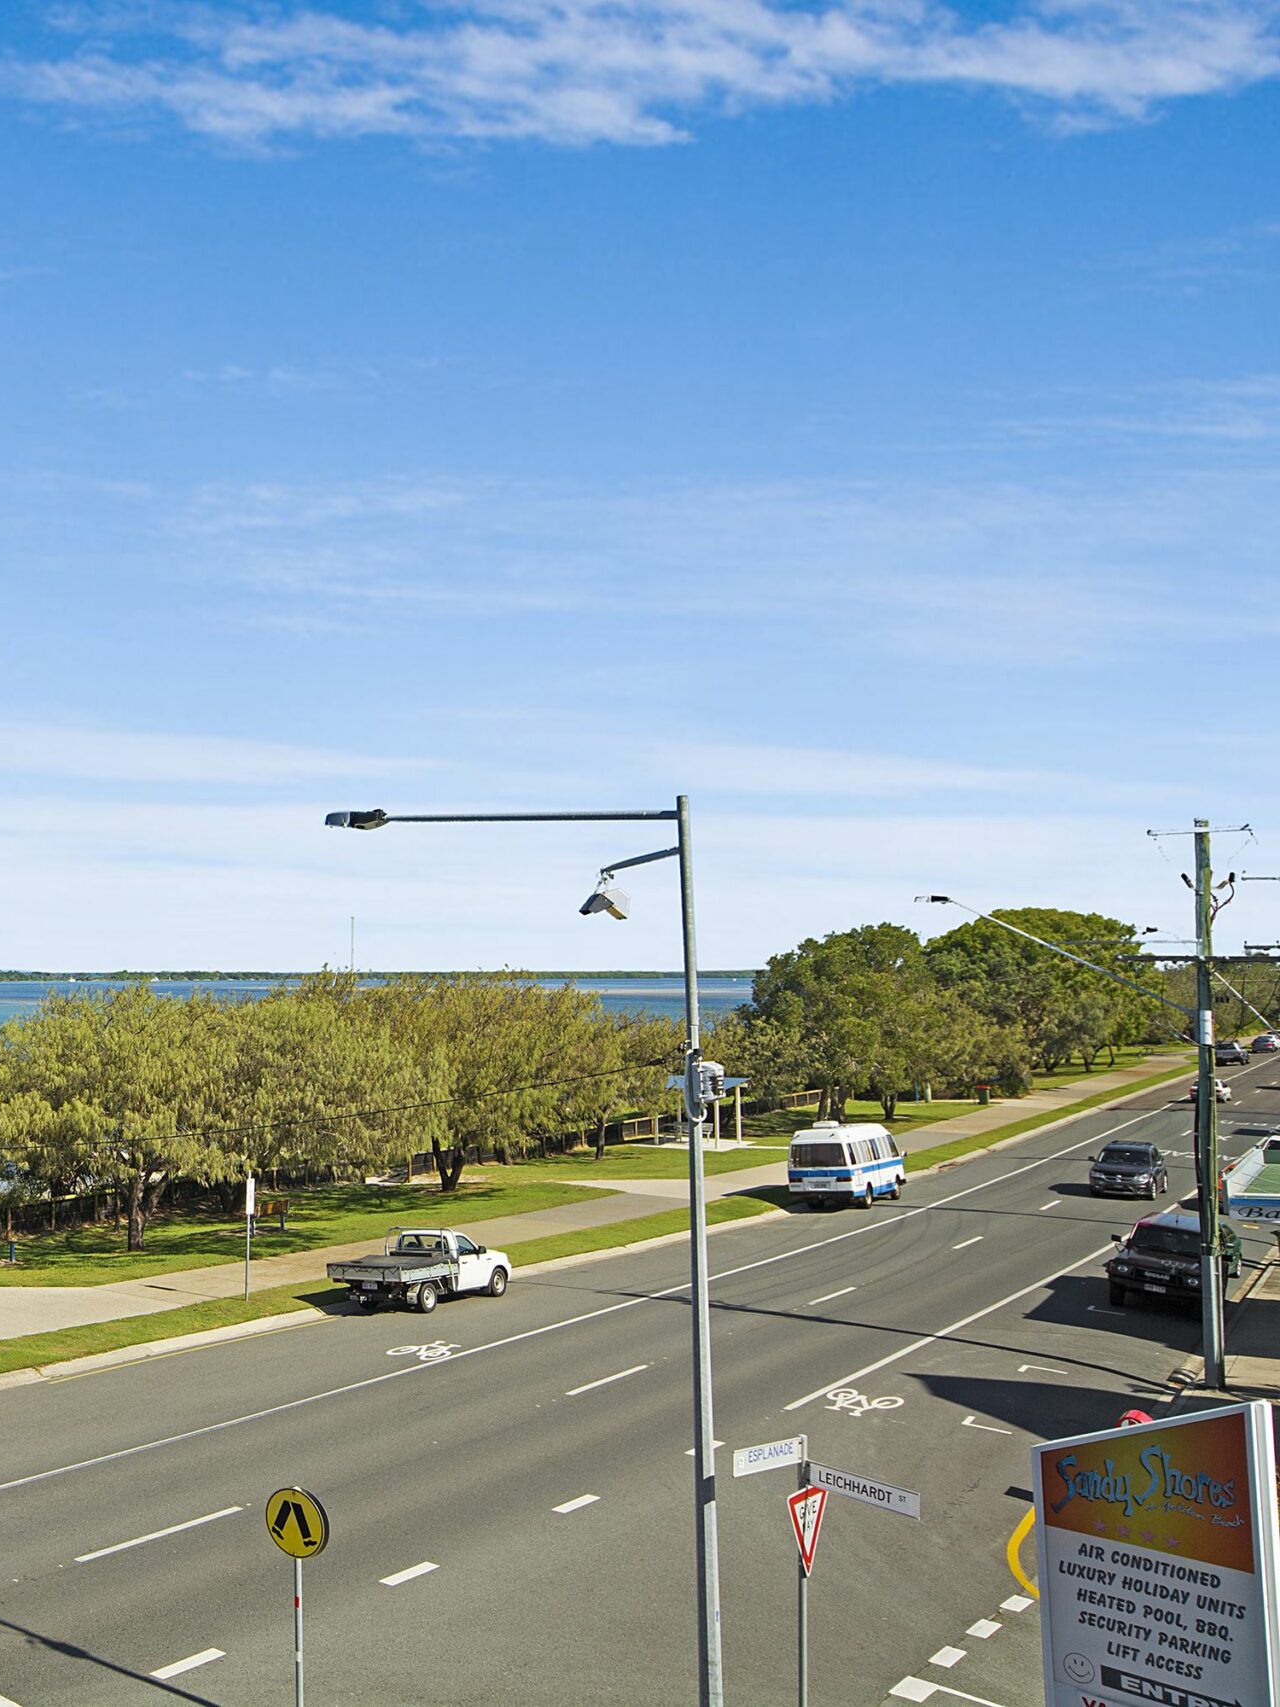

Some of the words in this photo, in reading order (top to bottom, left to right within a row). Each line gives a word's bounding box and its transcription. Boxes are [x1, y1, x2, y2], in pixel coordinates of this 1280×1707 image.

[1237, 1206, 1280, 1219] Ba
[748, 1442, 794, 1463] ESPLANADE
[818, 1470, 893, 1504] LEICHHARDT
[898, 1495, 907, 1503] ST
[1051, 1455, 1134, 1517] Sandy
[1133, 1445, 1236, 1508] Shores
[1077, 1542, 1105, 1562] AIR
[1111, 1550, 1221, 1589] CONDITIONED
[1058, 1560, 1116, 1586] LUXURY
[1122, 1576, 1190, 1605] HOLIDAY
[1196, 1594, 1246, 1620] UNITS
[1077, 1588, 1136, 1614] HEATED
[1143, 1605, 1188, 1631] POOL,
[1195, 1618, 1234, 1642] BBQ.
[1078, 1611, 1152, 1641] SECURITY
[1158, 1632, 1232, 1664] PARKING
[1107, 1641, 1140, 1662] LIFT
[1145, 1652, 1203, 1680] ACCESS
